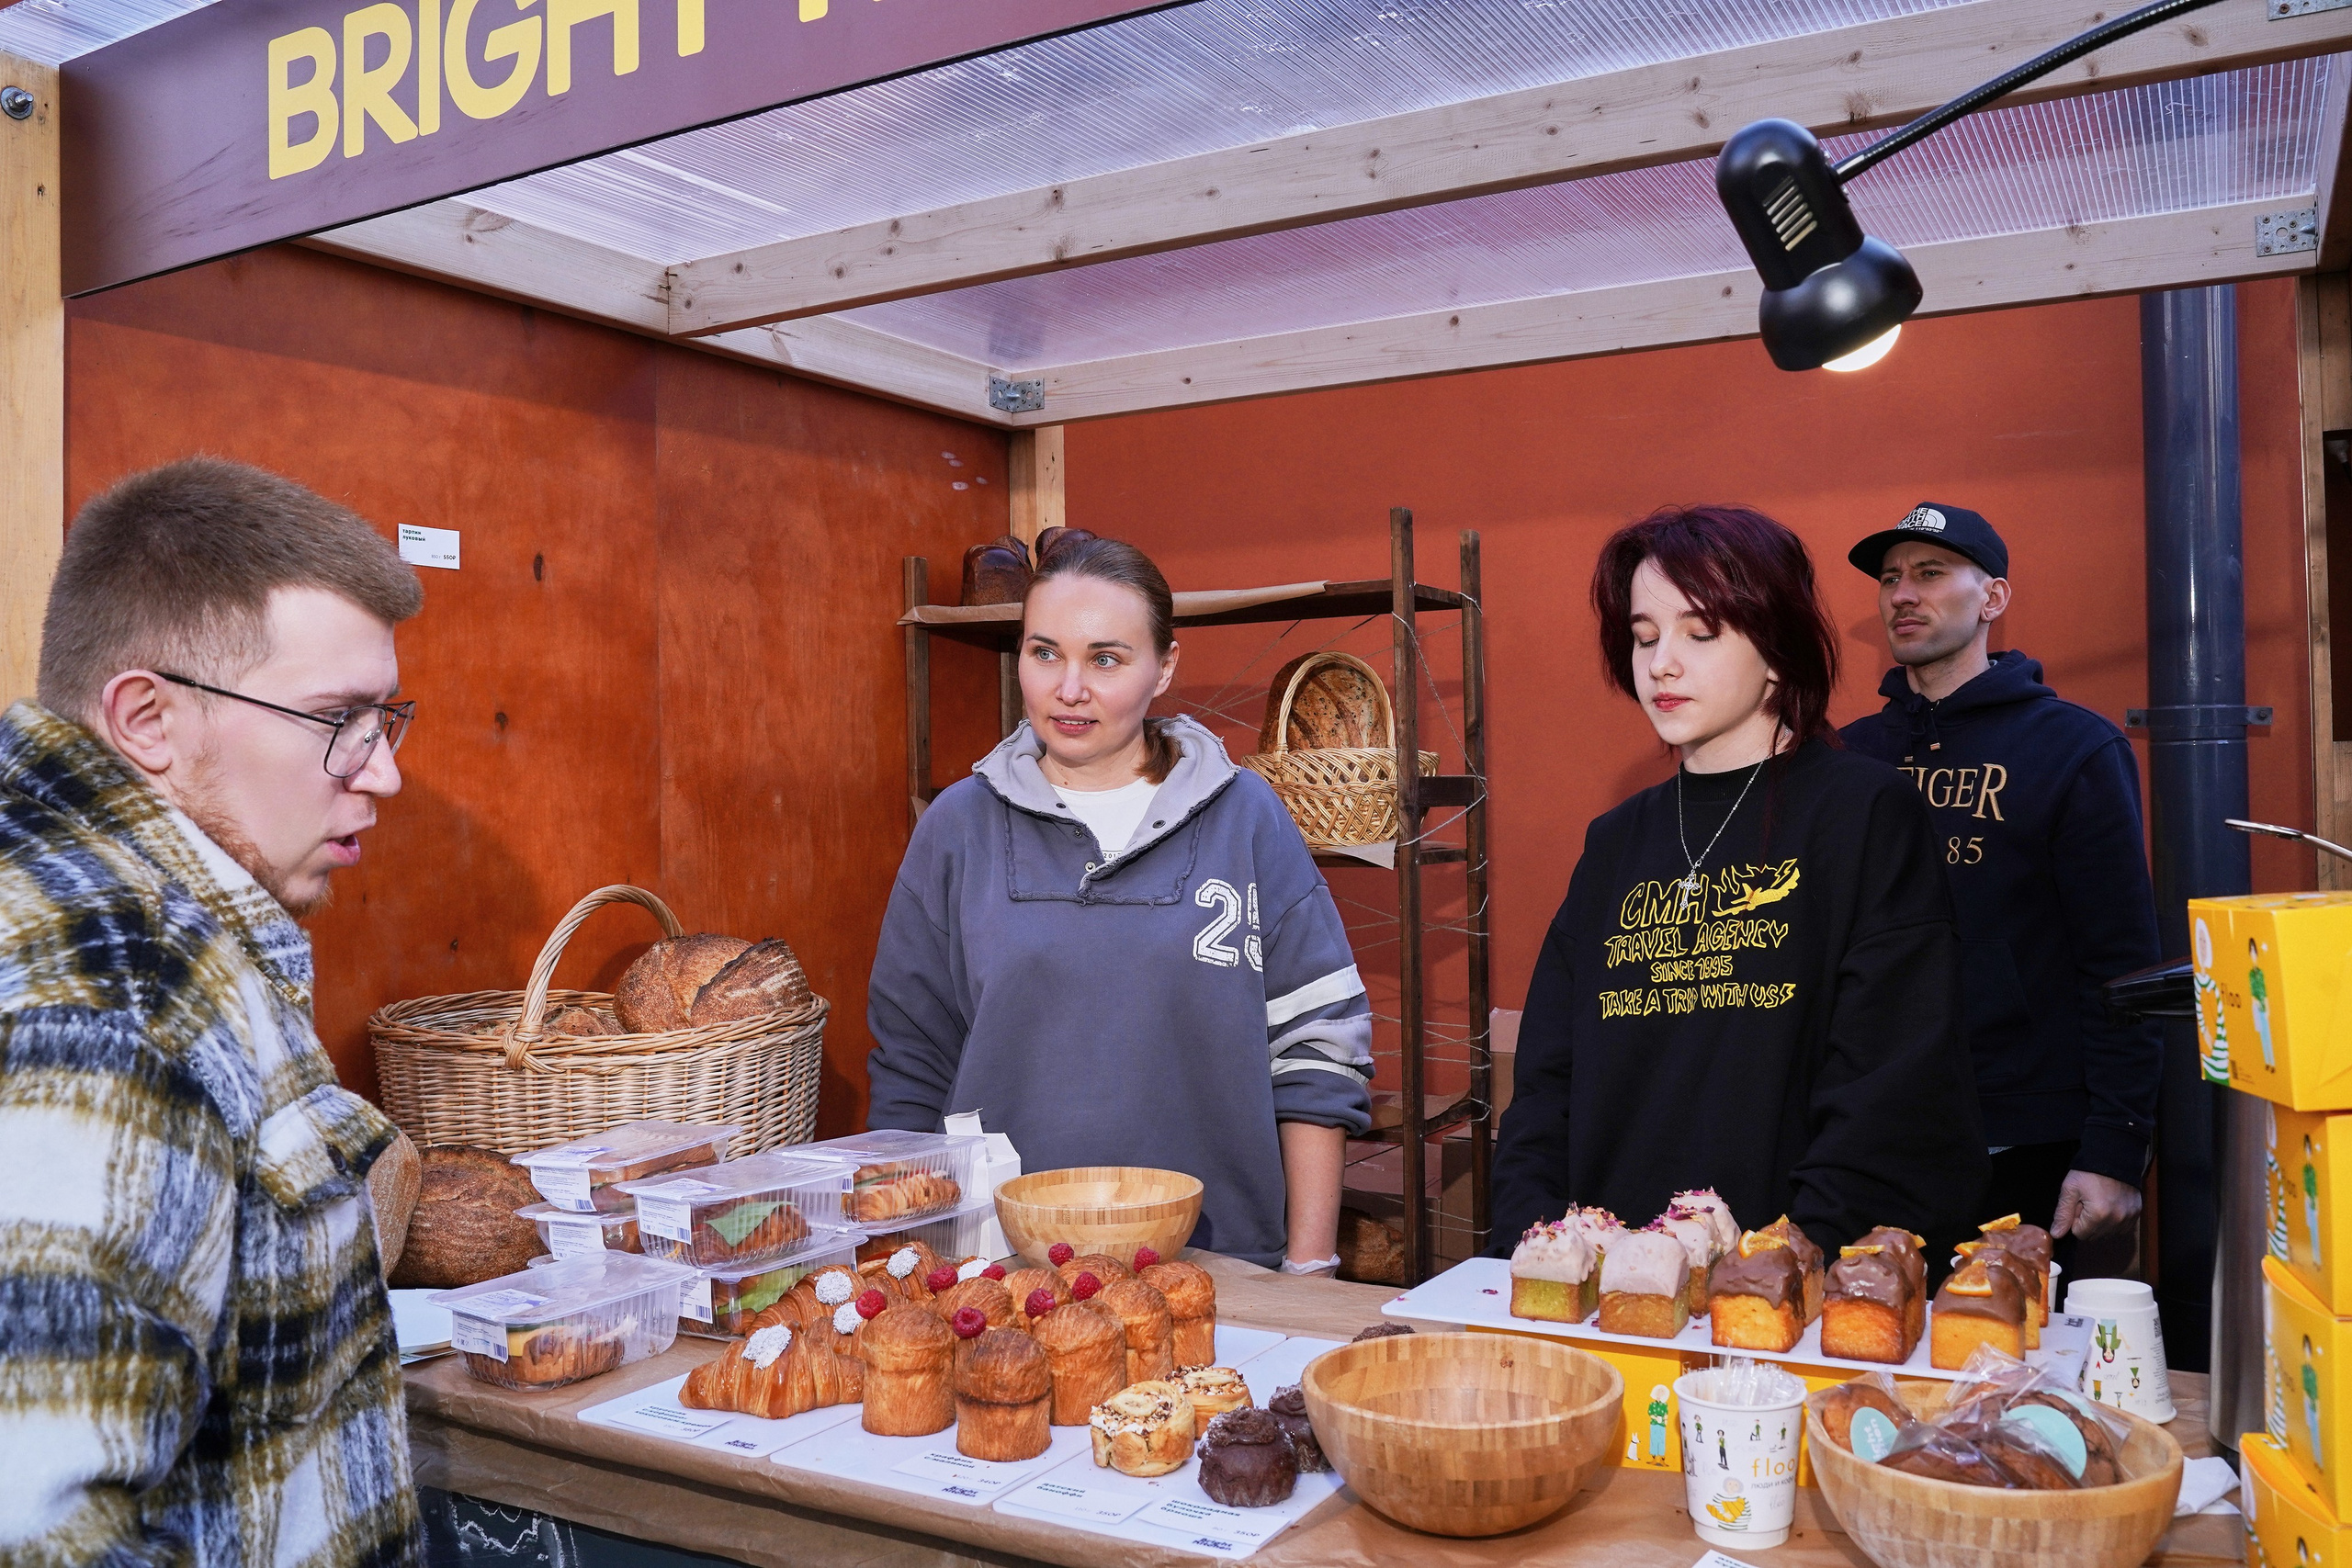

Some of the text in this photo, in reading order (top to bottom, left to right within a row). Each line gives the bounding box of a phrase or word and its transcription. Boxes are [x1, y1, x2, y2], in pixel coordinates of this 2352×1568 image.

[1946, 836, 1984, 864] 85
[1620, 874, 1710, 930] CMH
[1604, 919, 1789, 969] TRAVEL AGENCY
[1650, 955, 1734, 983] SINCE 1995
[1600, 982, 1780, 1020] TAKE A TRIP WITH US
[930, 1452, 973, 1463] краффин
[1751, 1457, 1795, 1478] floo
[1160, 1506, 1203, 1519] бриошь
[1166, 1503, 1211, 1516] булочка
[1171, 1499, 1240, 1517] шоколадная
